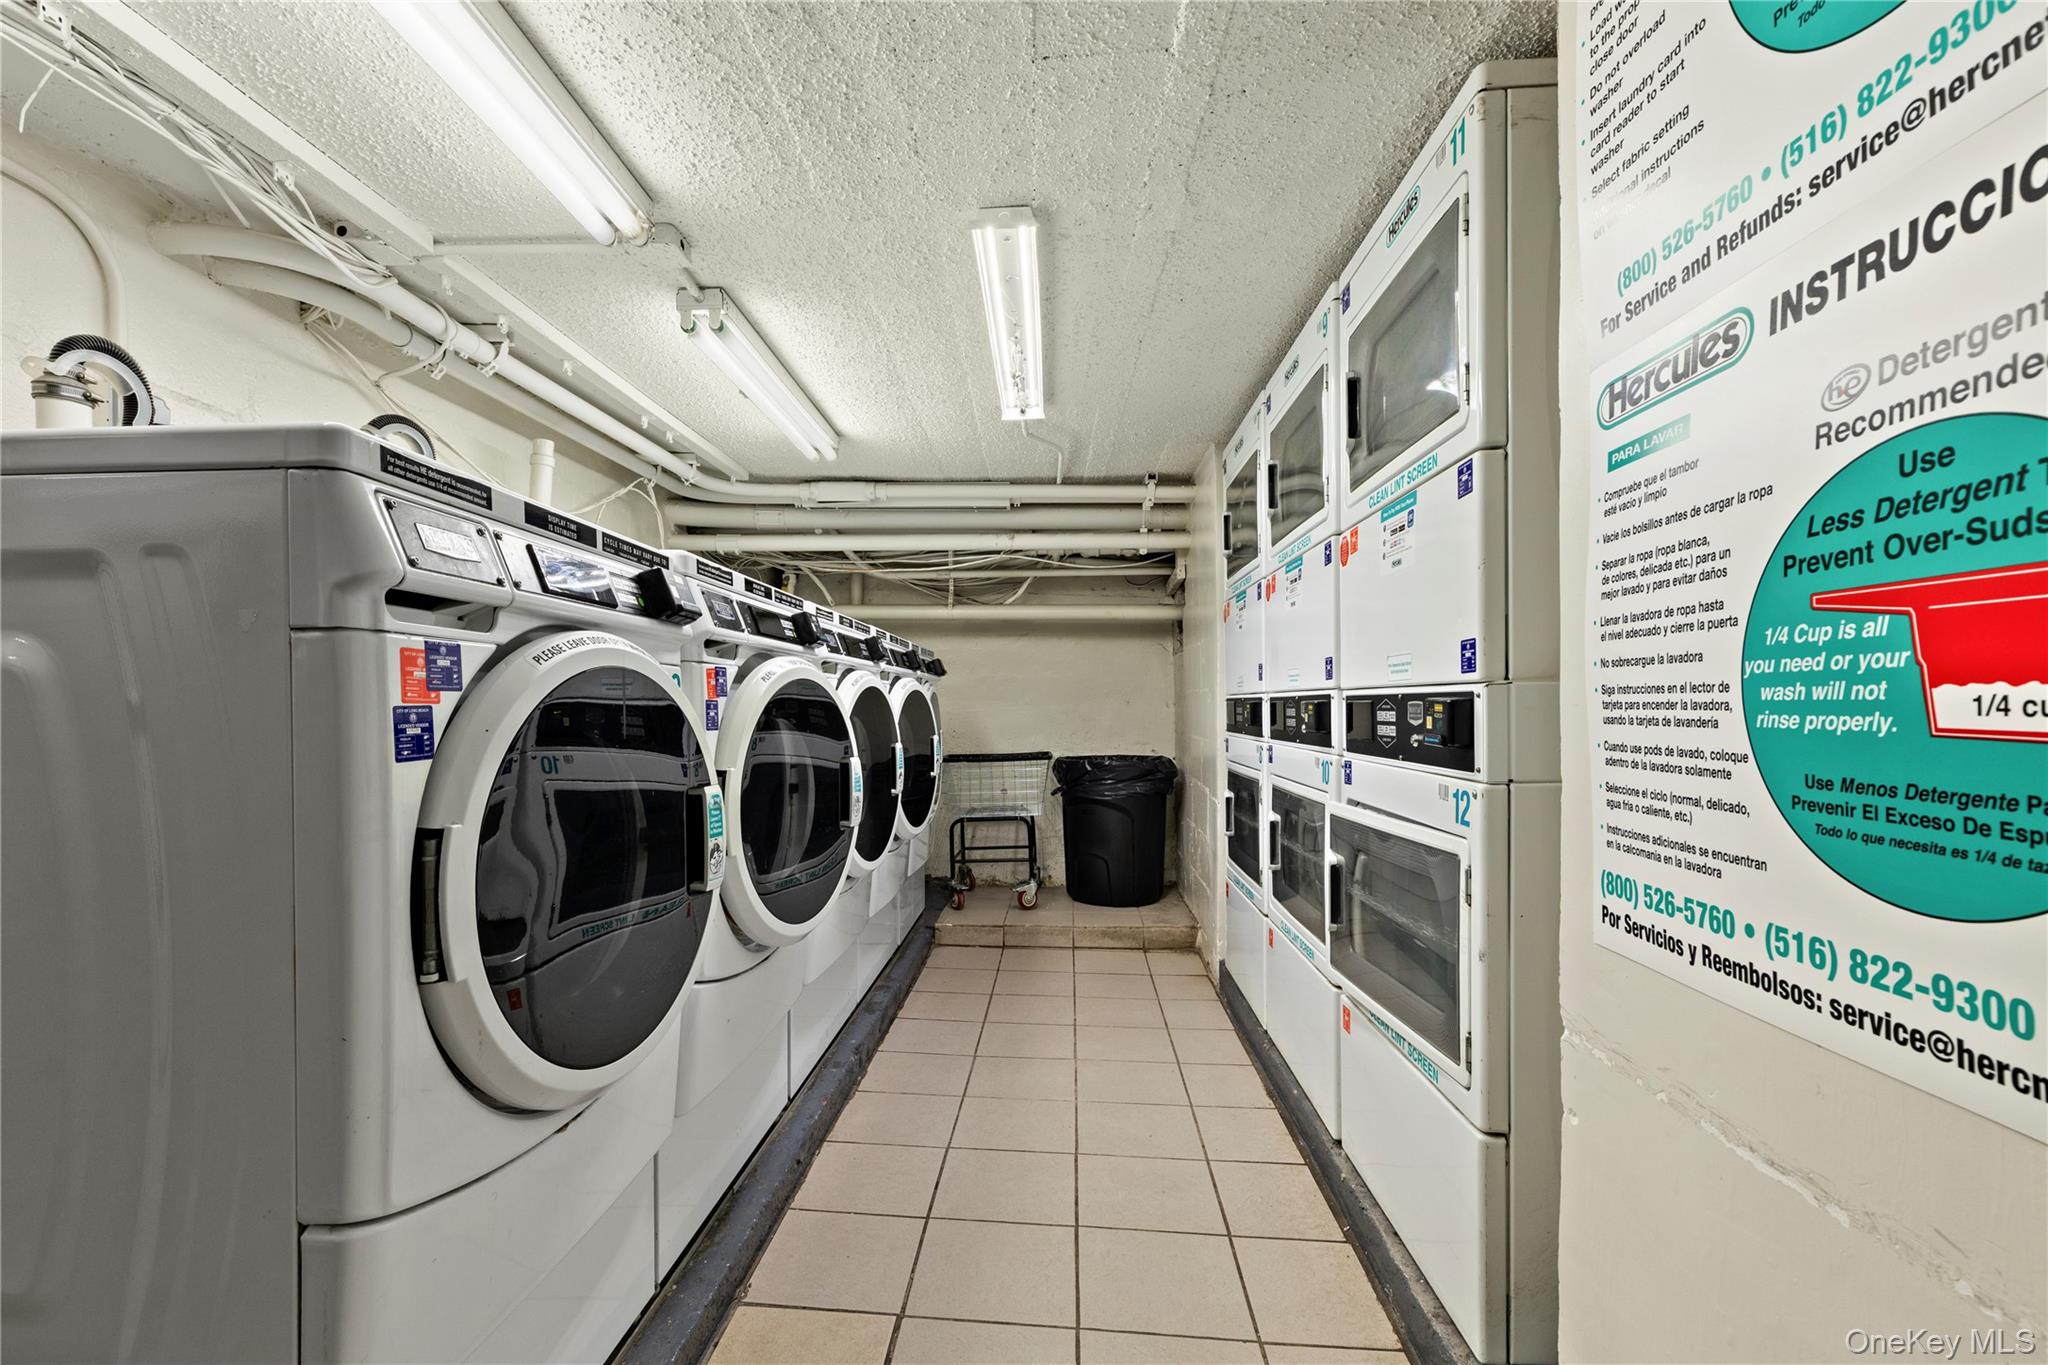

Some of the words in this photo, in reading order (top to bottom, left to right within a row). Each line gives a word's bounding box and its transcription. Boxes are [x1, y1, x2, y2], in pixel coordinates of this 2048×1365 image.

[1590, 7, 1612, 41] Load
[1590, 45, 1614, 76] close
[1616, 16, 1639, 47] door
[1605, 61, 1620, 84] not
[1622, 9, 1666, 65] overload
[1590, 108, 1617, 141] Insert
[1619, 70, 1655, 113] laundry
[1658, 40, 1682, 73] card
[1684, 18, 1706, 46] into
[1590, 77, 1623, 117] washer
[1590, 131, 1611, 158] card
[1613, 100, 1645, 137] reader
[1660, 58, 1686, 91] start
[1450, 117, 1466, 166] 11
[1590, 139, 1625, 175] washer
[1622, 141, 1650, 173] fabric
[1652, 104, 1690, 145] setting
[1641, 120, 1705, 182] instructions
[1617, 248, 1657, 297] (800)
[1662, 174, 1753, 261] 526-5760
[1781, 104, 1847, 179] (516)
[1600, 312, 1622, 338] For
[1625, 275, 1677, 322] Service
[1682, 245, 1711, 284] and
[1717, 186, 1802, 260] Refunds:
[1608, 320, 1741, 420] Hercules
[1611, 442, 1641, 465] PARA
[1643, 423, 1684, 450] LAVAR
[1898, 445, 1956, 478] Use
[1368, 487, 1389, 509] CLEAN
[1390, 475, 1406, 495] LINT
[1407, 452, 1438, 486] SCREEN
[1604, 479, 1642, 503] Compruebe
[1668, 458, 1700, 479] tambor
[1633, 515, 1663, 535] bolsillos
[1665, 510, 1688, 526] antes
[1690, 503, 1701, 518] de
[1704, 495, 1734, 514] cargar
[1749, 484, 1773, 503] ropa
[1807, 507, 1865, 538] Less
[1874, 463, 2029, 524] Detergent
[548, 514, 566, 527] DISPLAY
[567, 521, 577, 531] TIME
[554, 525, 577, 540] ESTIMATED
[603, 536, 618, 548] CYCLE
[619, 542, 632, 553] TIMES
[1601, 555, 1627, 572] Separar
[1636, 549, 1653, 563] ropa
[1655, 545, 1676, 560] (ropa
[1678, 535, 1710, 552] blanca,
[1783, 540, 1874, 578] Prevent
[1611, 568, 1638, 584] colores,
[1640, 559, 1673, 577] delicada
[1674, 553, 1693, 570] etc.)
[1695, 551, 1716, 567] para
[1719, 547, 1731, 560] un
[1621, 580, 1645, 597] lavado
[1653, 577, 1671, 592] para
[1672, 571, 1697, 588] evitar
[1699, 565, 1728, 582] daños
[1625, 623, 1661, 639] adecuado
[1670, 621, 1695, 634] cierre
[1707, 615, 1739, 631] puerta
[1630, 608, 1662, 623] lavadora
[1677, 603, 1696, 617] ropa
[1698, 599, 1724, 613] hasta
[1765, 626, 1788, 646] 1/4
[1794, 622, 1833, 647] Cup
[1838, 619, 1856, 640] is
[1862, 615, 1890, 638] all
[532, 642, 567, 665] PLEASE
[562, 636, 590, 650] LEAVE
[1611, 654, 1655, 669] sobrecargue
[1667, 650, 1703, 663] lavadora
[1744, 659, 1775, 679] you
[1780, 651, 1826, 673] need
[1830, 653, 1854, 671] or
[1858, 650, 1911, 675] your
[1617, 683, 1665, 695] instrucciones
[1689, 681, 1715, 693] lector
[1718, 681, 1730, 693] de
[1642, 700, 1678, 711] encender
[1690, 699, 1733, 713] lavadora,
[1760, 682, 1806, 702] wash
[1812, 680, 1847, 701] will
[1851, 680, 1888, 701] not
[1972, 693, 2012, 718] 1/4
[1636, 715, 1660, 728] tarjeta
[1756, 710, 1800, 730] rinse
[1804, 711, 1898, 738] properly.
[1604, 739, 1629, 753] Cuando
[1644, 743, 1663, 757] pods
[1677, 745, 1708, 762] lavado,
[1710, 749, 1749, 765] coloque
[1605, 756, 1630, 768] adentro
[1649, 760, 1683, 775] lavadora
[1685, 764, 1732, 780] solamente
[1321, 760, 1330, 785] 10
[1452, 788, 1471, 828] 12
[1605, 781, 1640, 798] Seleccione
[1650, 789, 1668, 803] ciclo
[1670, 791, 1704, 810] (normal,
[1706, 797, 1750, 818] delicado,
[1804, 773, 1835, 791] Use
[1840, 777, 1899, 798] Menos
[1905, 783, 2020, 812] Detergente
[1641, 803, 1673, 821] caliente,
[1674, 810, 1693, 825] etc.)
[1791, 795, 1857, 818] Prevenir
[1862, 803, 1879, 821] El
[1885, 807, 1956, 833] Exceso
[1963, 816, 1992, 838] De
[1607, 822, 1650, 843] Instrucciones
[1652, 834, 1697, 855] adicionales
[1712, 848, 1767, 872] encuentran
[1814, 823, 1843, 839] Todo
[1846, 828, 1858, 841] lo
[1861, 833, 1885, 847] que
[1889, 835, 1947, 857] necesita
[1951, 847, 1969, 860] es
[1974, 849, 1997, 865] 1/4
[2002, 854, 2023, 869] de
[1685, 858, 1722, 878] lavadora
[1601, 868, 1638, 910] (800)
[1644, 883, 1736, 940] 526-5760
[1765, 922, 1839, 982] (516)
[1849, 948, 2036, 1042] 822-9300
[1601, 904, 1621, 927] Por
[1624, 913, 1684, 958] Servicios
[1687, 943, 1697, 967] y
[1702, 942, 1824, 1014] Reembolsos:
[1391, 1028, 1406, 1050] LINT
[1407, 1042, 1439, 1085] SCREEN
